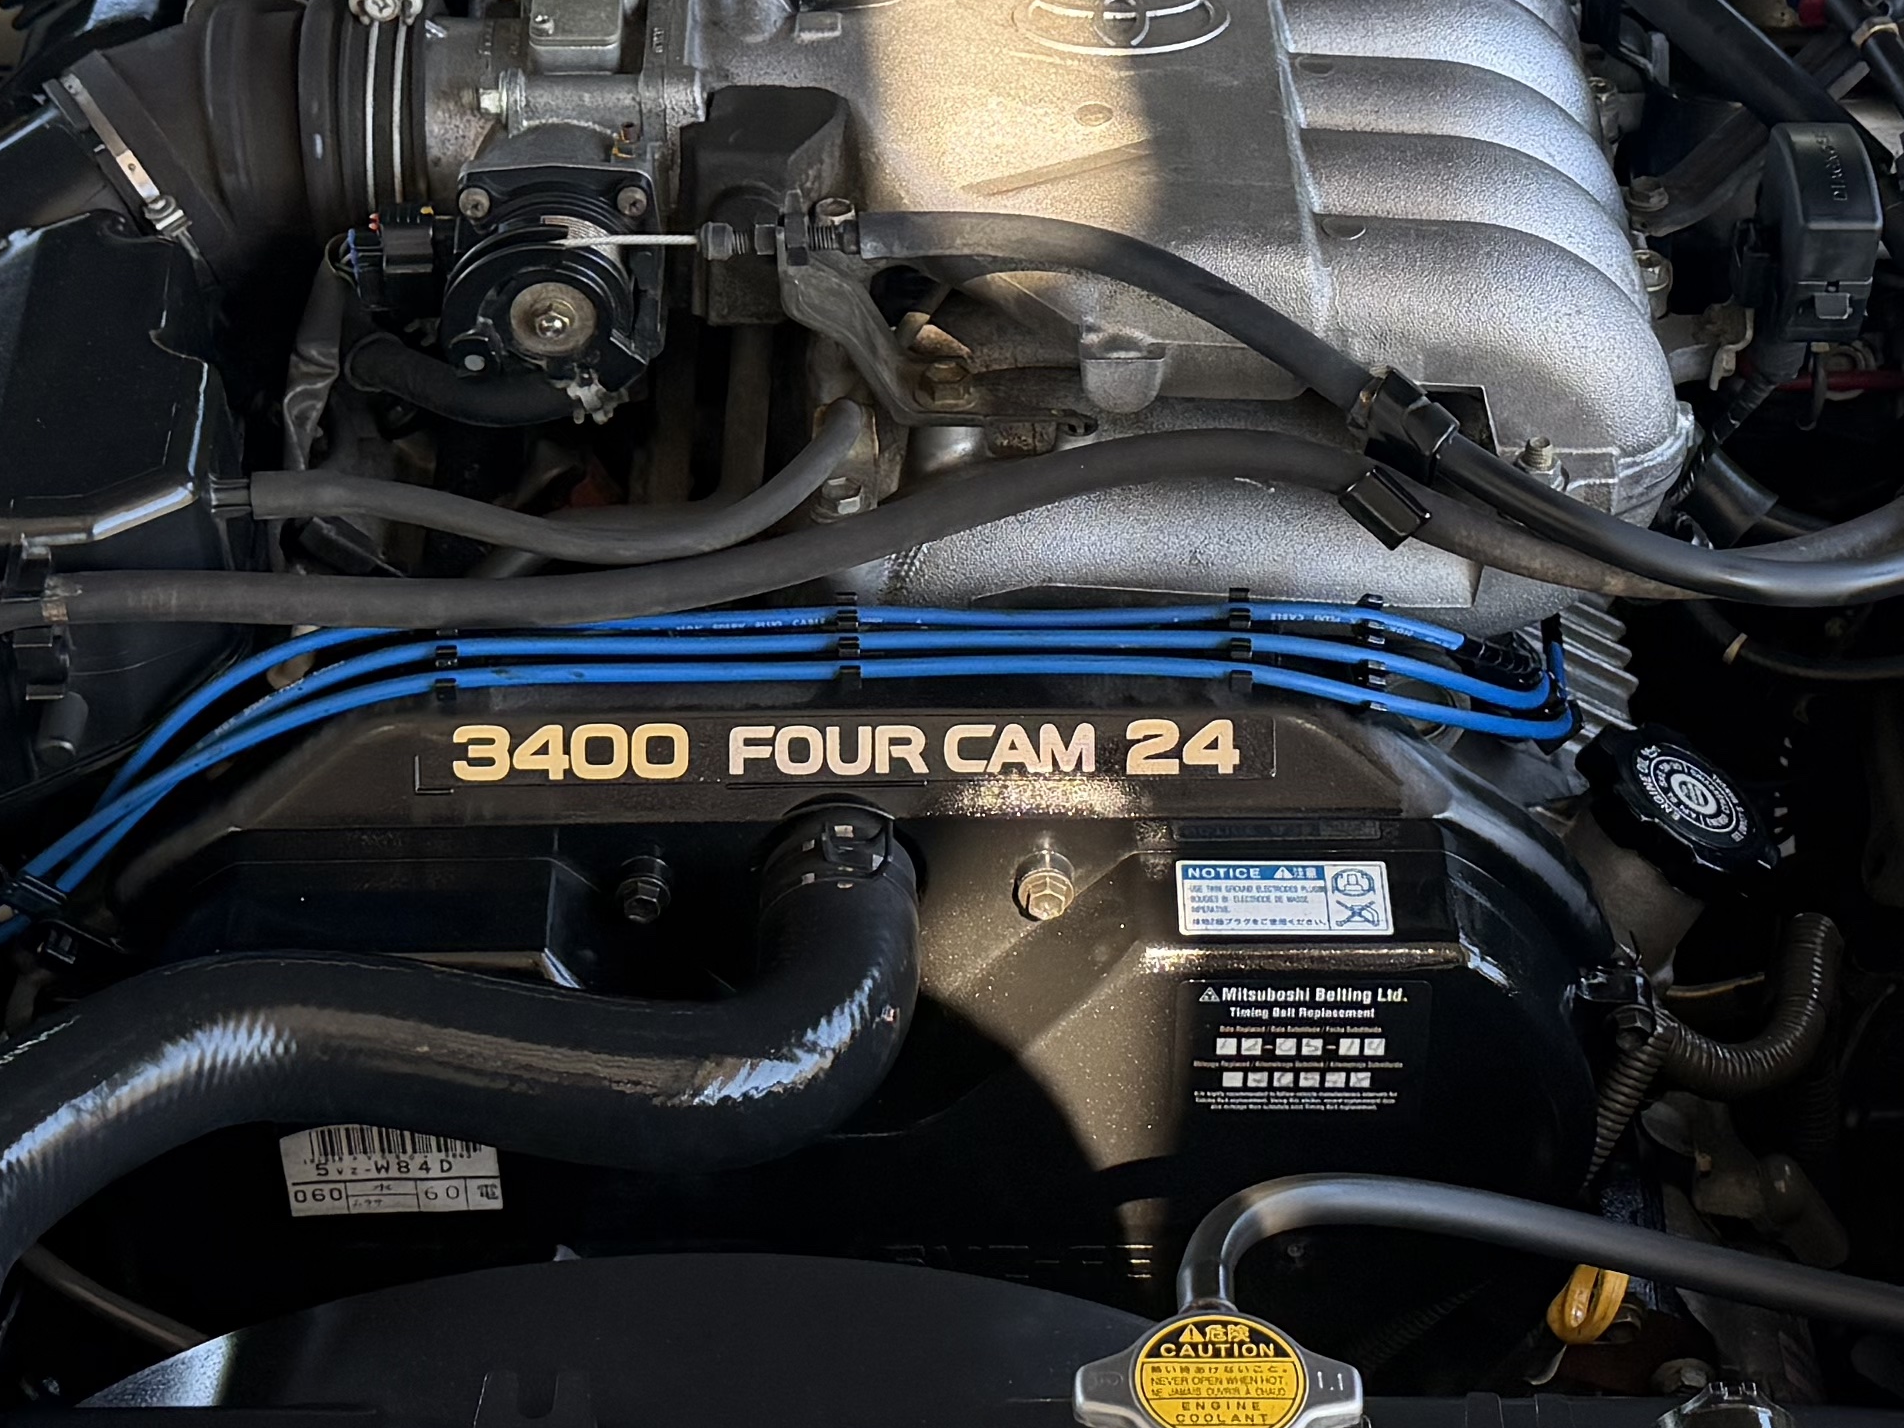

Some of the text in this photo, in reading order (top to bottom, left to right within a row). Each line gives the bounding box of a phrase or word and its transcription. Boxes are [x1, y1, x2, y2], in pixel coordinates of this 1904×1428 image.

[451, 718, 1242, 781] 3400 FOUR CAM 24
[1187, 868, 1261, 879] NOTICE
[1222, 987, 1408, 1004] Mitsuboshi Belting Ltd.
[1229, 1007, 1375, 1020] Timing Belt Replacement
[294, 1187, 343, 1203] 060
[1206, 1325, 1250, 1342] 危険
[1160, 1343, 1275, 1357] CAUTION
[1151, 1377, 1188, 1386] NEVER
[1192, 1377, 1223, 1386] OPEN
[1226, 1377, 1259, 1386] WHEN
[1317, 1371, 1344, 1391] 1.1
[1181, 1402, 1261, 1411] ENGINE
[1176, 1413, 1268, 1423] COOLANT
